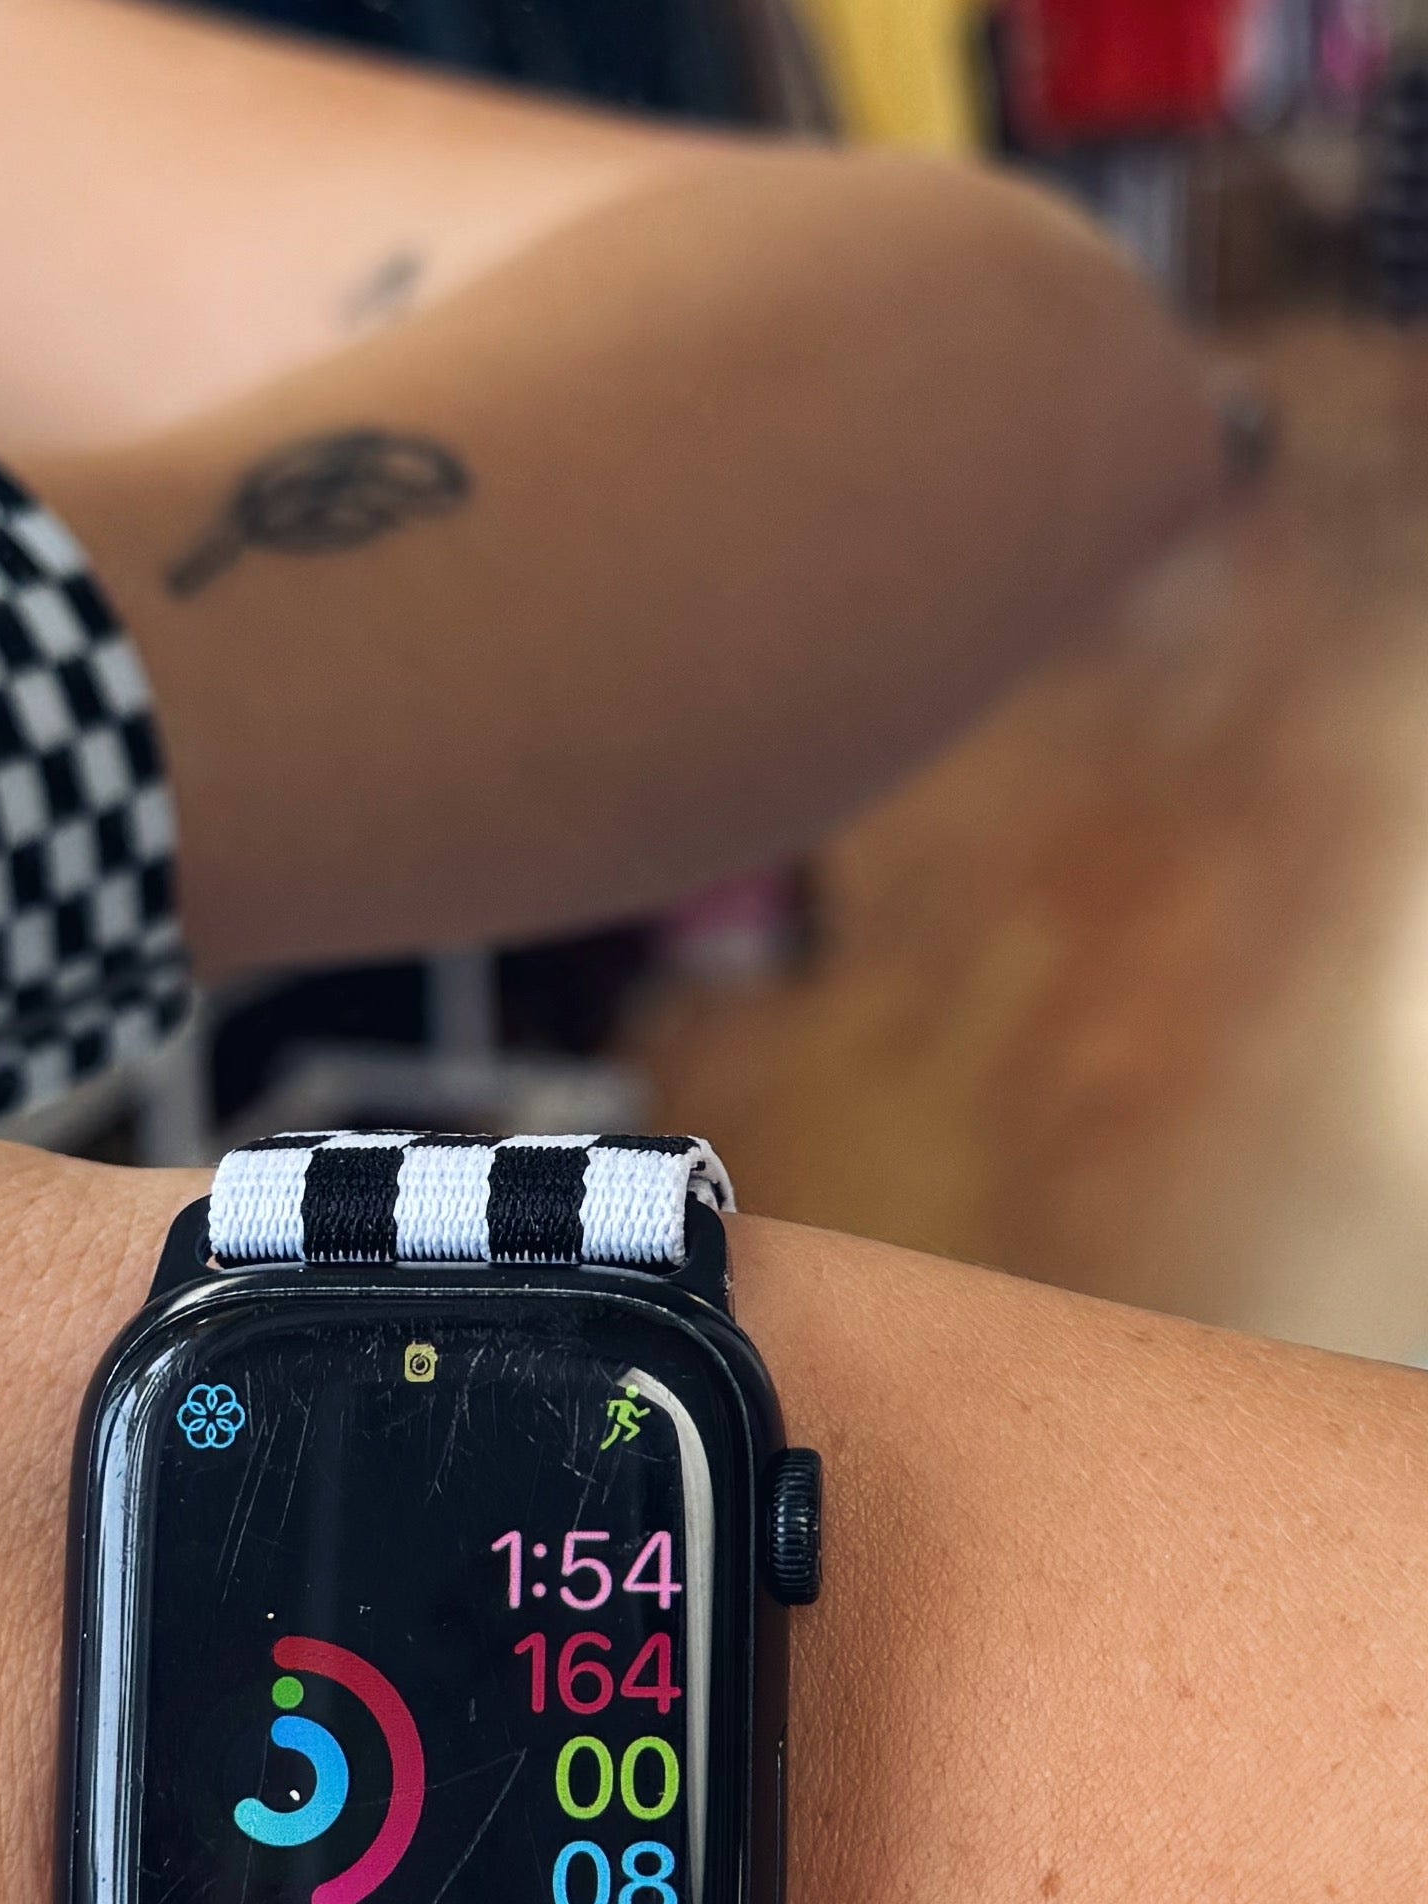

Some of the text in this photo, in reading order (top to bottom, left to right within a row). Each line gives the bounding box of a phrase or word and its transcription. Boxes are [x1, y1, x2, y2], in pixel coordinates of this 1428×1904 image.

[491, 1530, 682, 1610] 1:54
[514, 1632, 682, 1714] 164
[555, 1735, 679, 1820] 00
